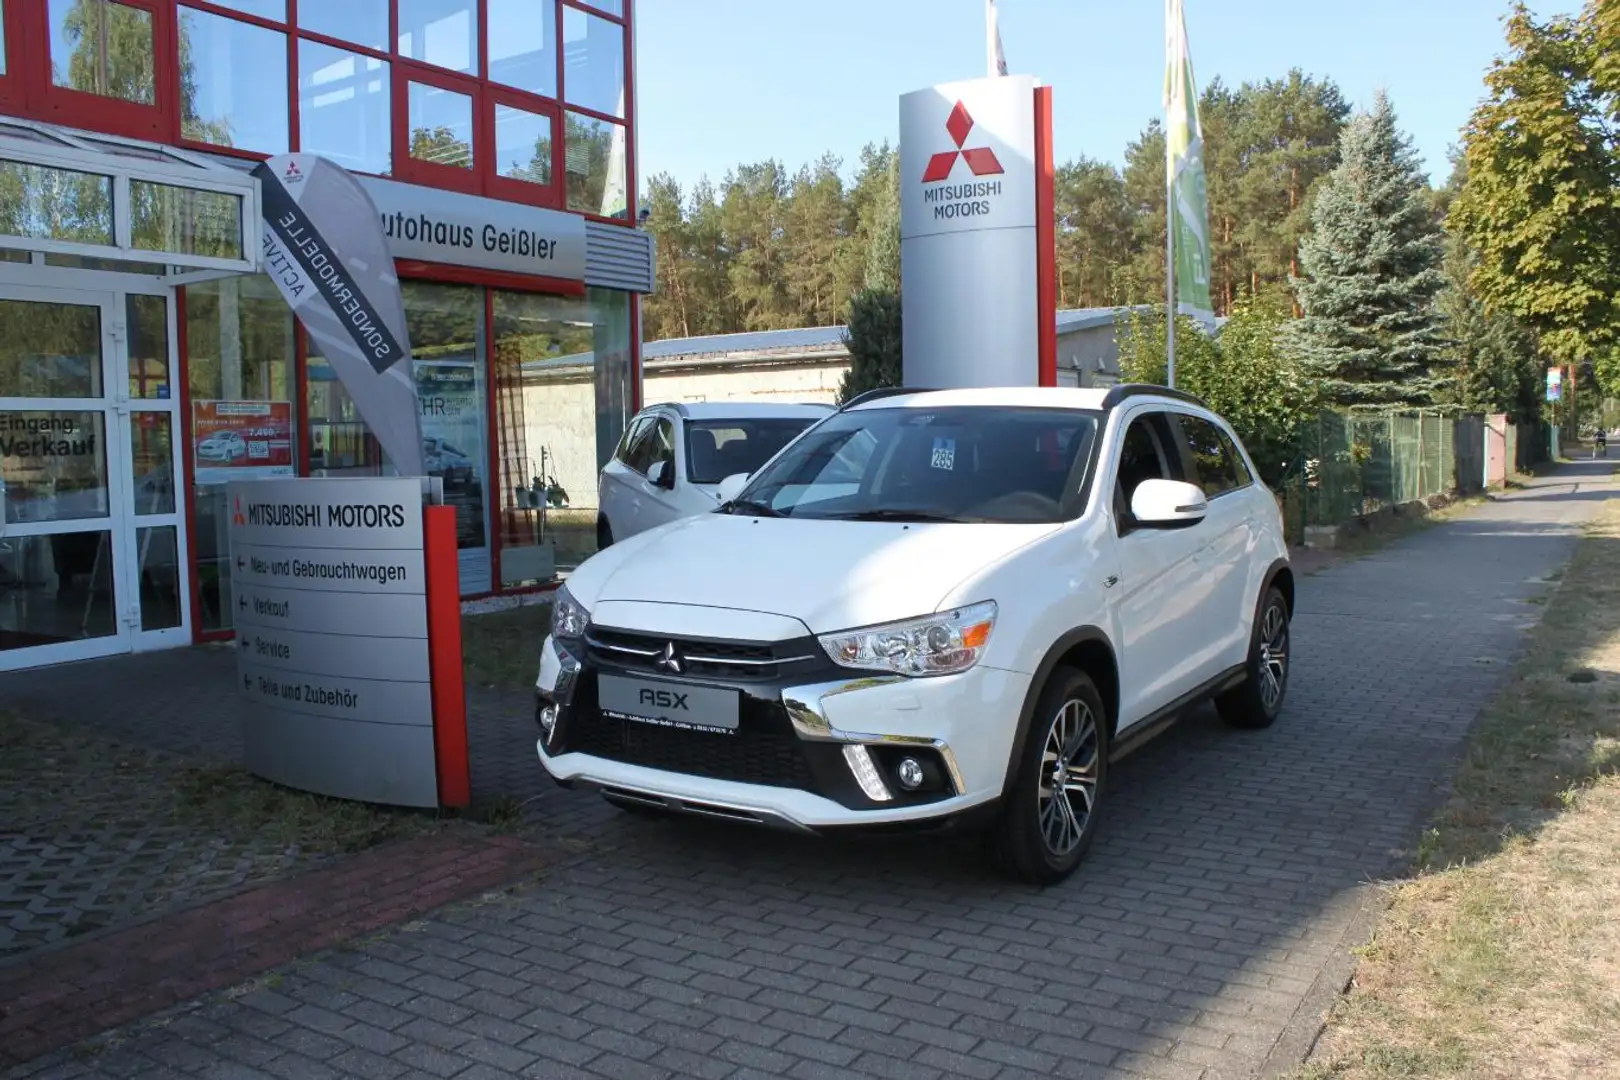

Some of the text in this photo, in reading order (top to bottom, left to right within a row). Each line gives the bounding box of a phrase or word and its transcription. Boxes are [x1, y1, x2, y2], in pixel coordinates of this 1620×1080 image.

[924, 181, 1002, 203] MITSUBISHI
[934, 200, 990, 220] MOTORS
[381, 211, 557, 260] utohaus Geißler
[0, 414, 74, 435] Eingang
[0, 435, 96, 457] Verkauf
[248, 503, 405, 528] MITSUBISHI MOTORS
[271, 559, 290, 576] und
[292, 559, 407, 584] Gebrauchtwagen
[253, 595, 289, 618] Verkauf
[256, 636, 290, 659] Service
[258, 676, 358, 708] Teile und Zubehör
[639, 688, 689, 711] ASX
